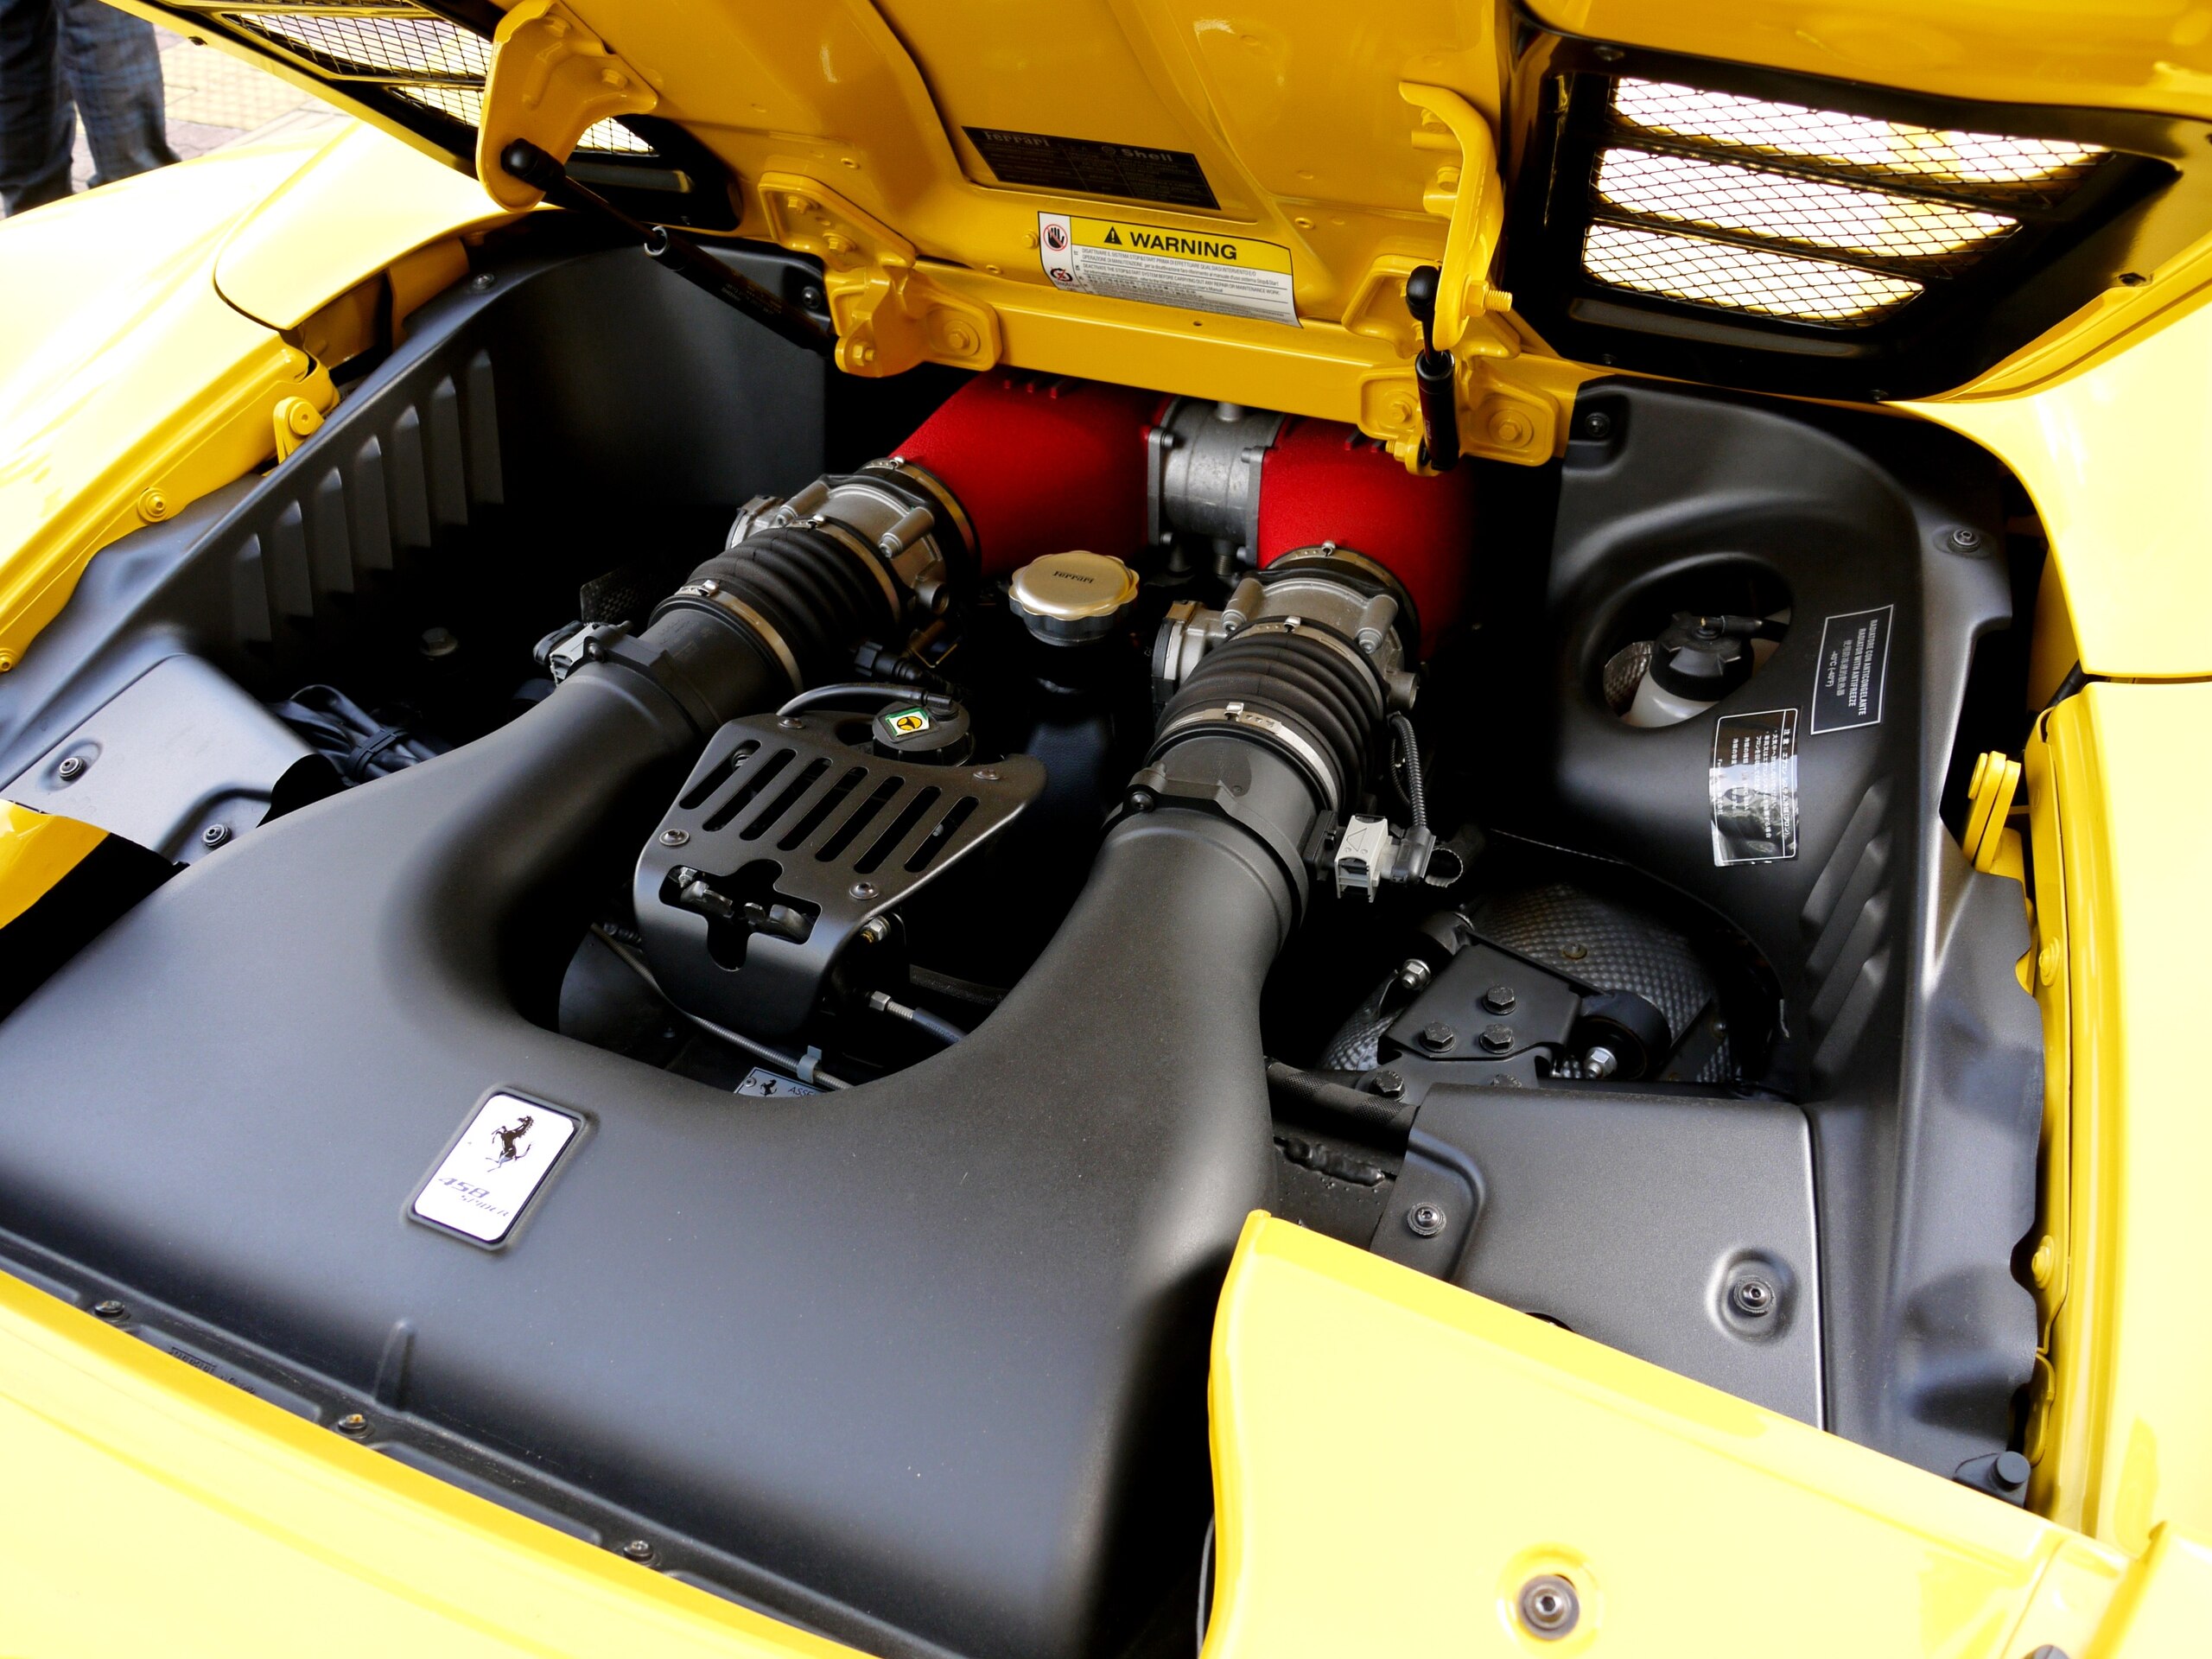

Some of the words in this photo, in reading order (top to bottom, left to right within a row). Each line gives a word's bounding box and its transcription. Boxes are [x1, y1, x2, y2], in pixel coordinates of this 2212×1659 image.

[983, 130, 1050, 148] Ferrari
[1121, 147, 1173, 162] Shell
[1129, 232, 1237, 260] WARNING
[1052, 570, 1095, 584] Ferrari
[1855, 628, 1866, 656] RADIATOR
[1866, 619, 1878, 650] RADIATORE
[1853, 656, 1862, 671] WITH
[1864, 650, 1873, 662] CON
[1848, 671, 1859, 708] ANTIFREEZE
[1858, 662, 1871, 715] ANTICONGELANTE
[788, 1086, 815, 1097] ASSE
[438, 1177, 491, 1199] 458
[461, 1195, 510, 1217] SPIDER
